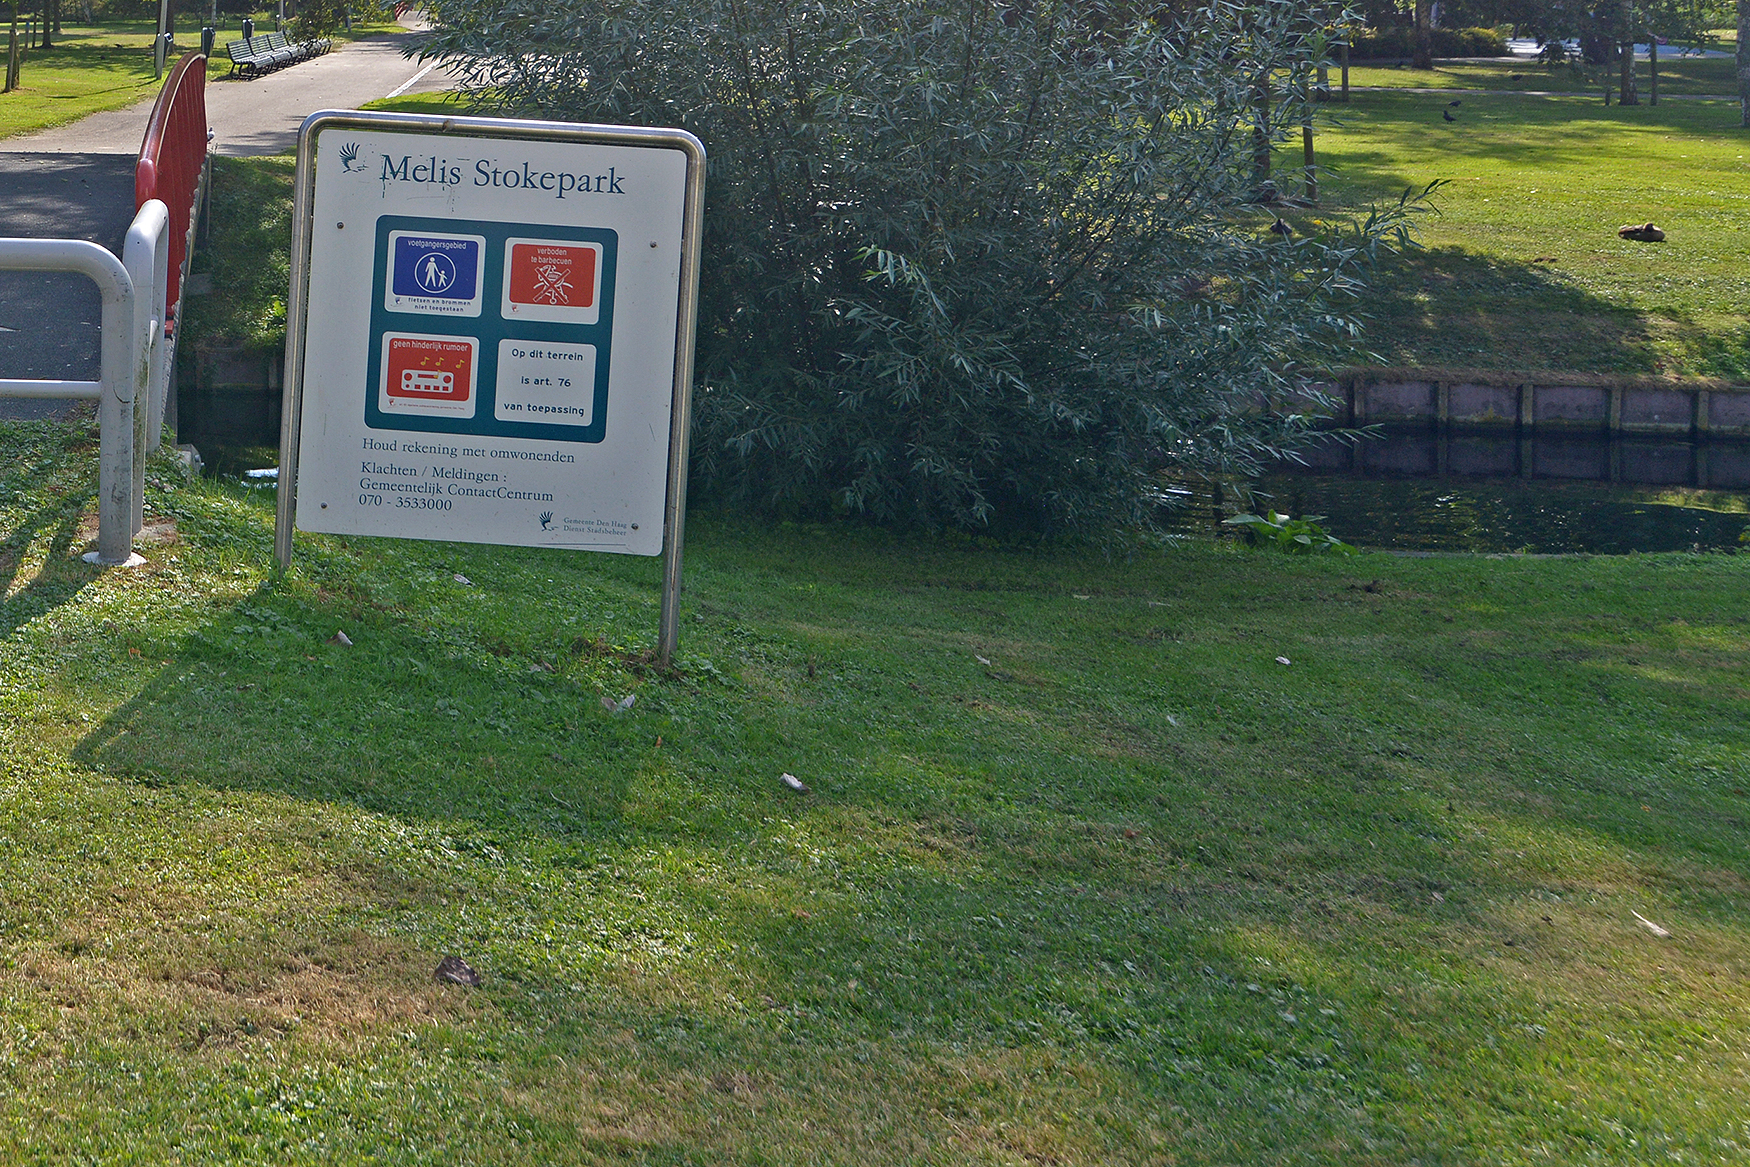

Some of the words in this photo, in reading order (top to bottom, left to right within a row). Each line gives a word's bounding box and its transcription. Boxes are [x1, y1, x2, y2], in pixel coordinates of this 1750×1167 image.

[380, 154, 461, 185] Melis
[473, 159, 625, 199] Stokepark
[407, 239, 467, 250] voetgangersgebied
[537, 247, 567, 256] verboden
[530, 255, 537, 264] te
[538, 256, 572, 265] barbecuen
[393, 341, 410, 349] geen
[411, 341, 442, 351] hinderlijk
[443, 343, 468, 352] rumoer
[511, 348, 526, 359] Op
[529, 349, 543, 359] dit
[547, 351, 584, 361] terrein
[521, 376, 530, 384] is
[533, 377, 552, 386] art.
[558, 378, 571, 387] 76
[504, 403, 523, 411] van
[527, 403, 585, 417] toepassing
[362, 438, 397, 452] Houd
[402, 441, 458, 458] rekening
[462, 446, 486, 457] met
[490, 449, 575, 463] omwonenden
[360, 461, 417, 476] Klachten
[431, 466, 499, 484] Meldingen
[359, 477, 443, 496] Gemeentelijk
[447, 483, 553, 502] ContactCentrum
[358, 494, 382, 506] 070
[395, 496, 452, 511] 3533000
[563, 517, 594, 525] Gemeente
[611, 520, 627, 529] Haag
[563, 525, 585, 533] Dienst
